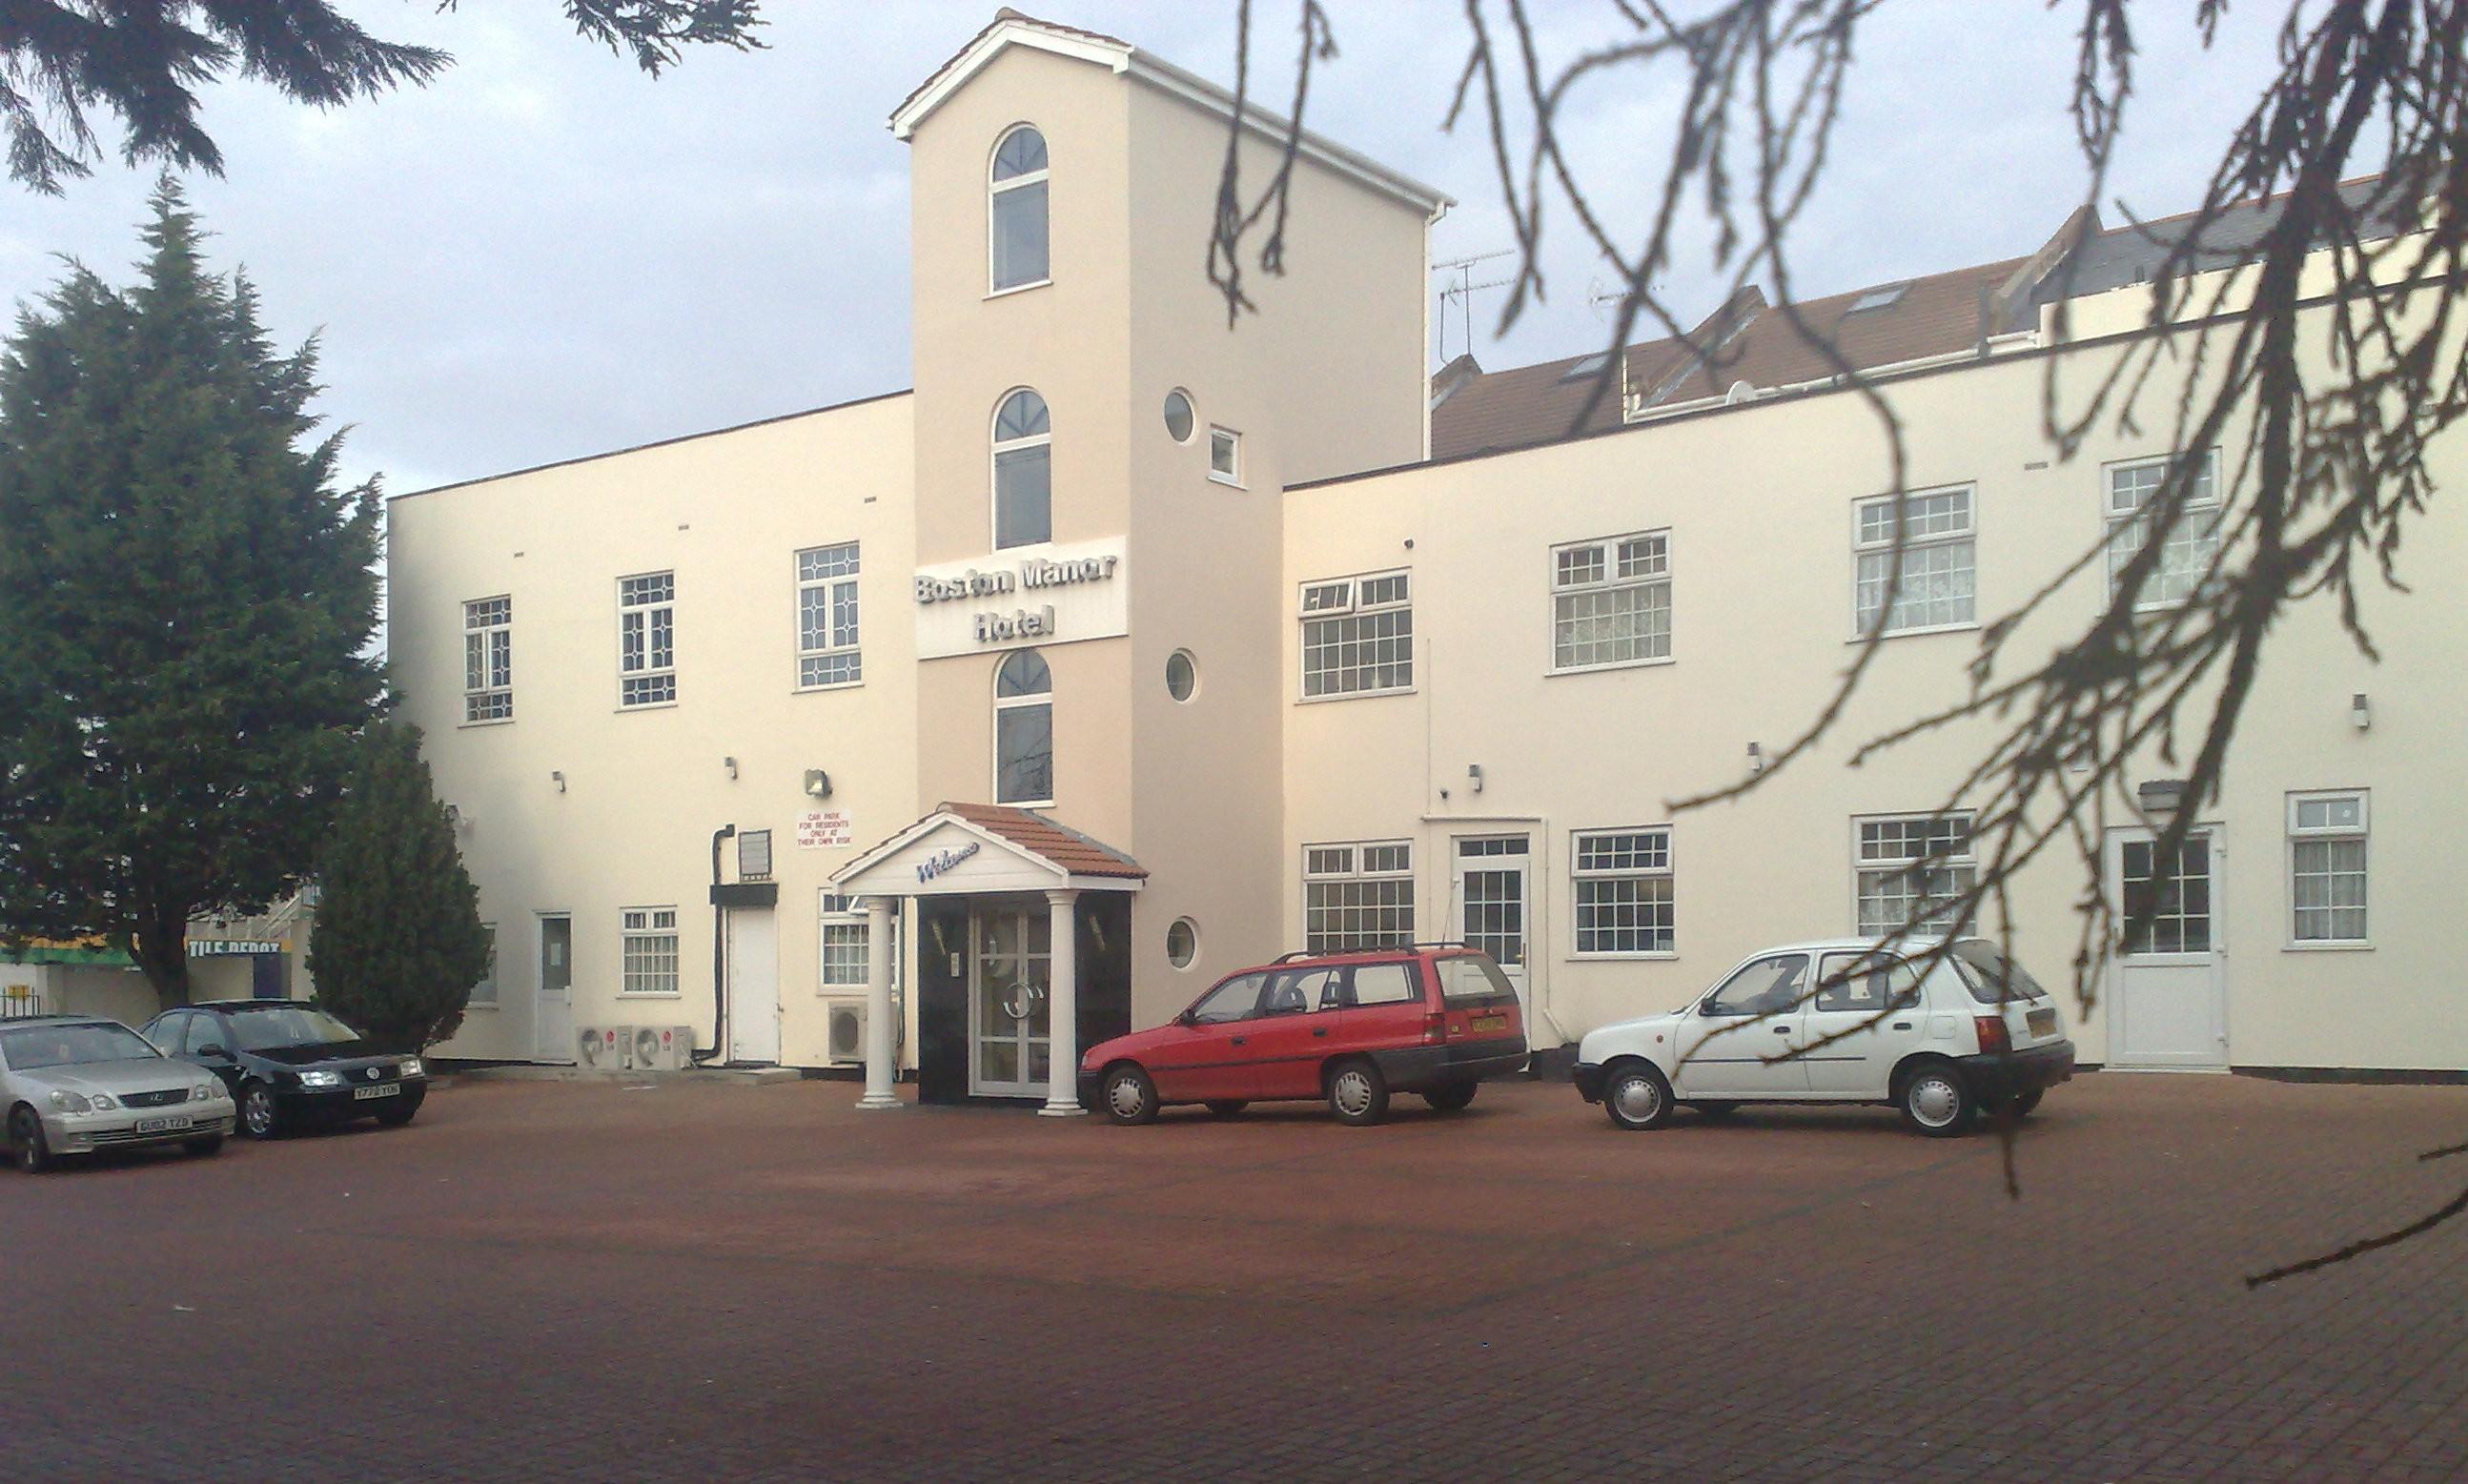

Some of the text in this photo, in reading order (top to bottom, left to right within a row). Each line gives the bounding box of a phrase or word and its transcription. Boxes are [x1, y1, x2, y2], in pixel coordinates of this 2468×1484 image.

[915, 555, 1117, 603] Boston Manor
[973, 604, 1054, 642] Hotel
[815, 820, 849, 828] RESIDENTS
[189, 940, 280, 957] TILE DEPOT
